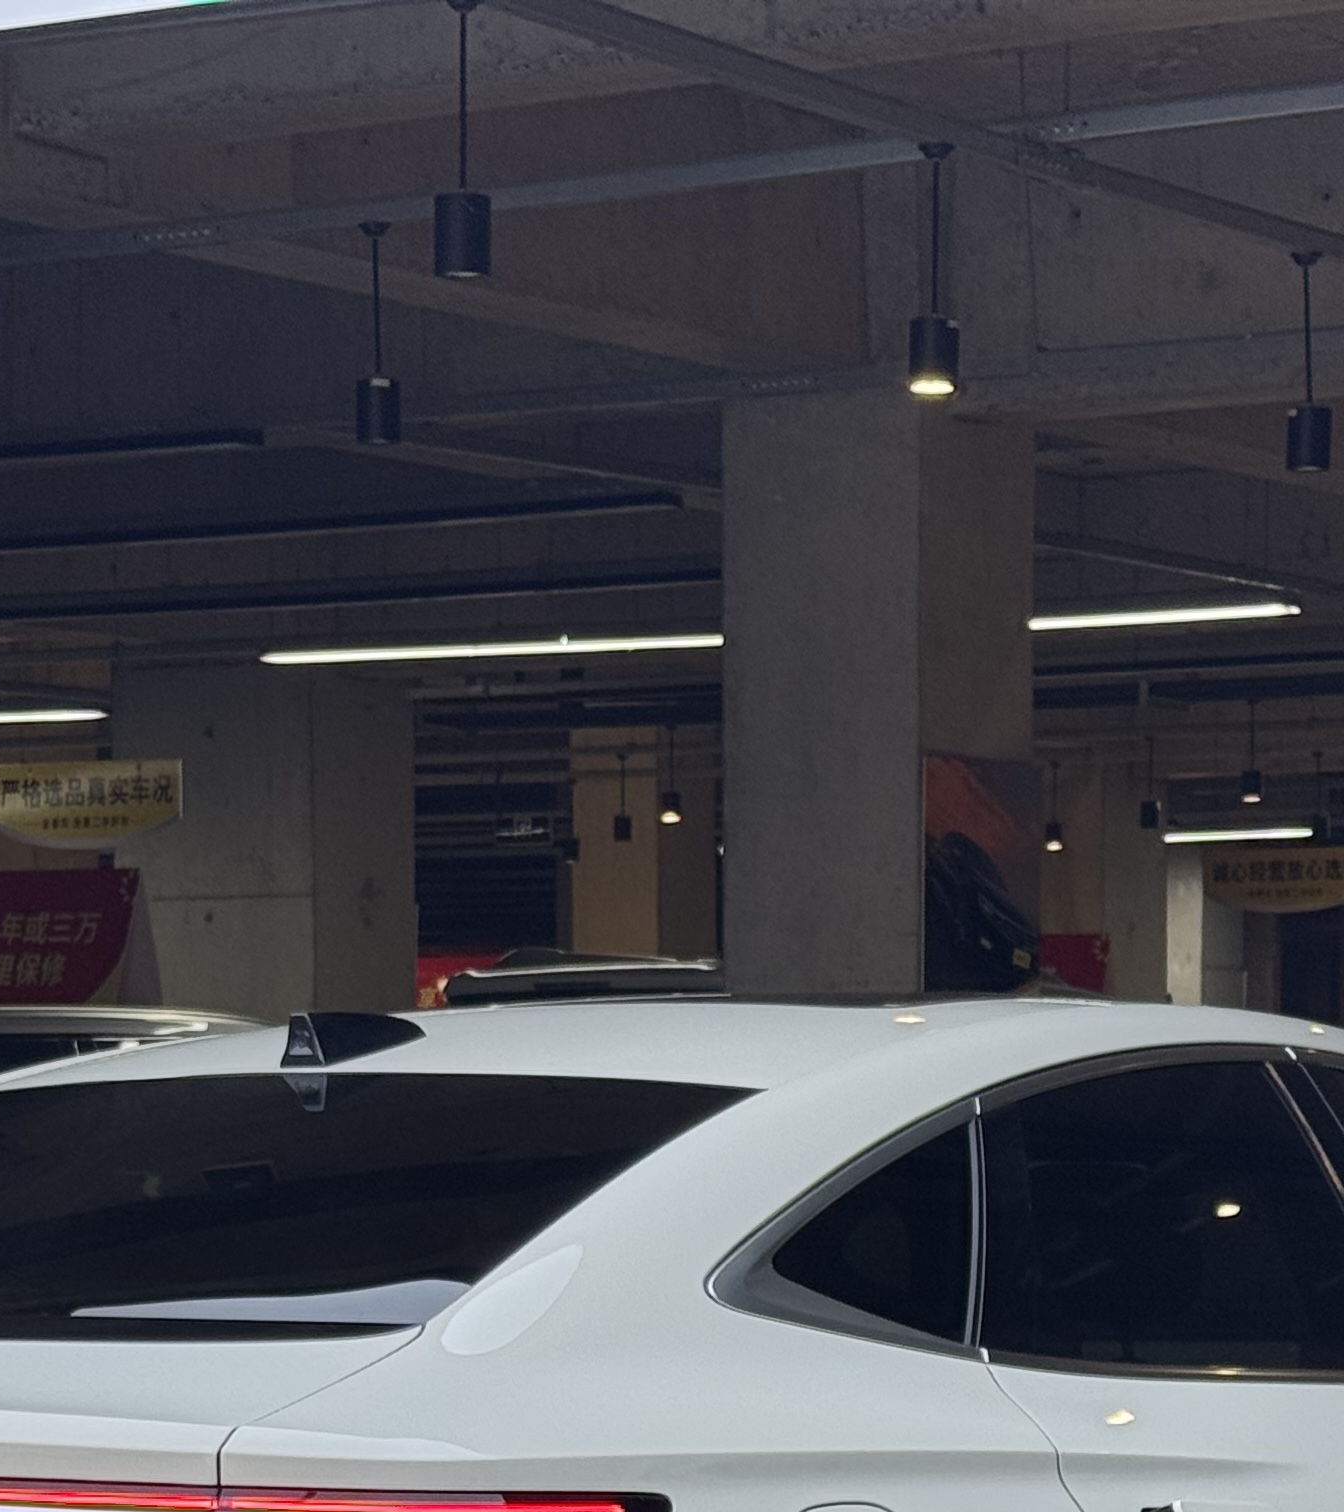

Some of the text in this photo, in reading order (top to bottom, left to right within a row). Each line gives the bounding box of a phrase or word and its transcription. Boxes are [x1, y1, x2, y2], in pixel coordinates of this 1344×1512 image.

[0, 775, 173, 808] 严格选品真实车况
